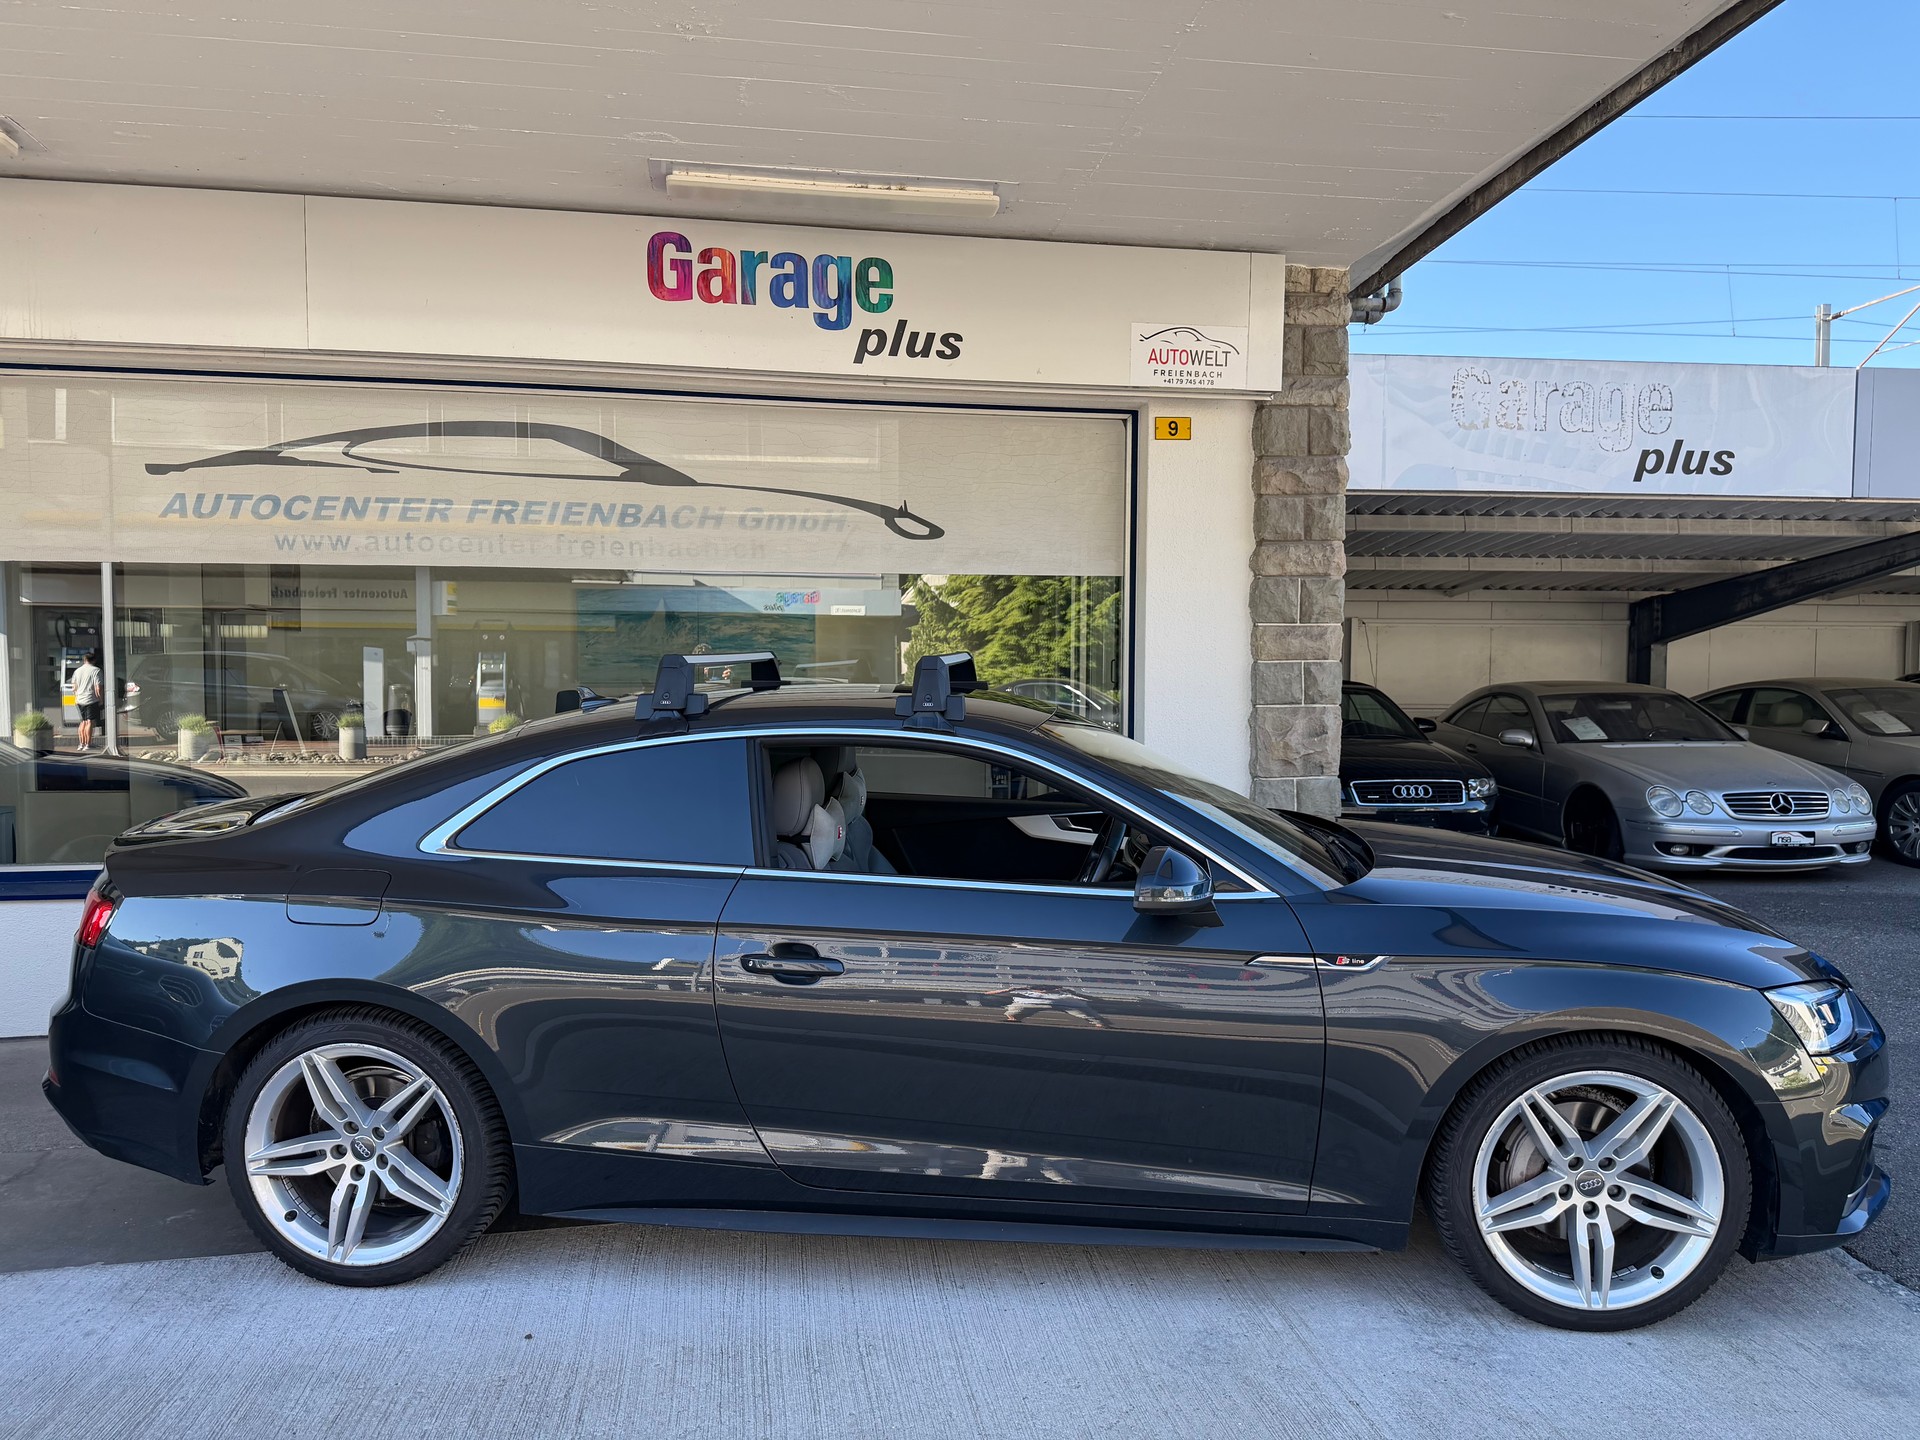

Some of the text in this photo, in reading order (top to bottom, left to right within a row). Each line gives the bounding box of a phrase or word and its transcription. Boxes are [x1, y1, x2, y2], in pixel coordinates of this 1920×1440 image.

[647, 231, 894, 331] Garage
[853, 319, 963, 364] plus
[1147, 348, 1231, 367] AUTOWELT
[1153, 369, 1223, 378] FREIENBACH
[1168, 420, 1178, 436] 9
[1451, 367, 1673, 452] Garage
[1633, 439, 1735, 482] plus
[158, 493, 849, 532] AUTOCENTER FREIENBACH GmbH
